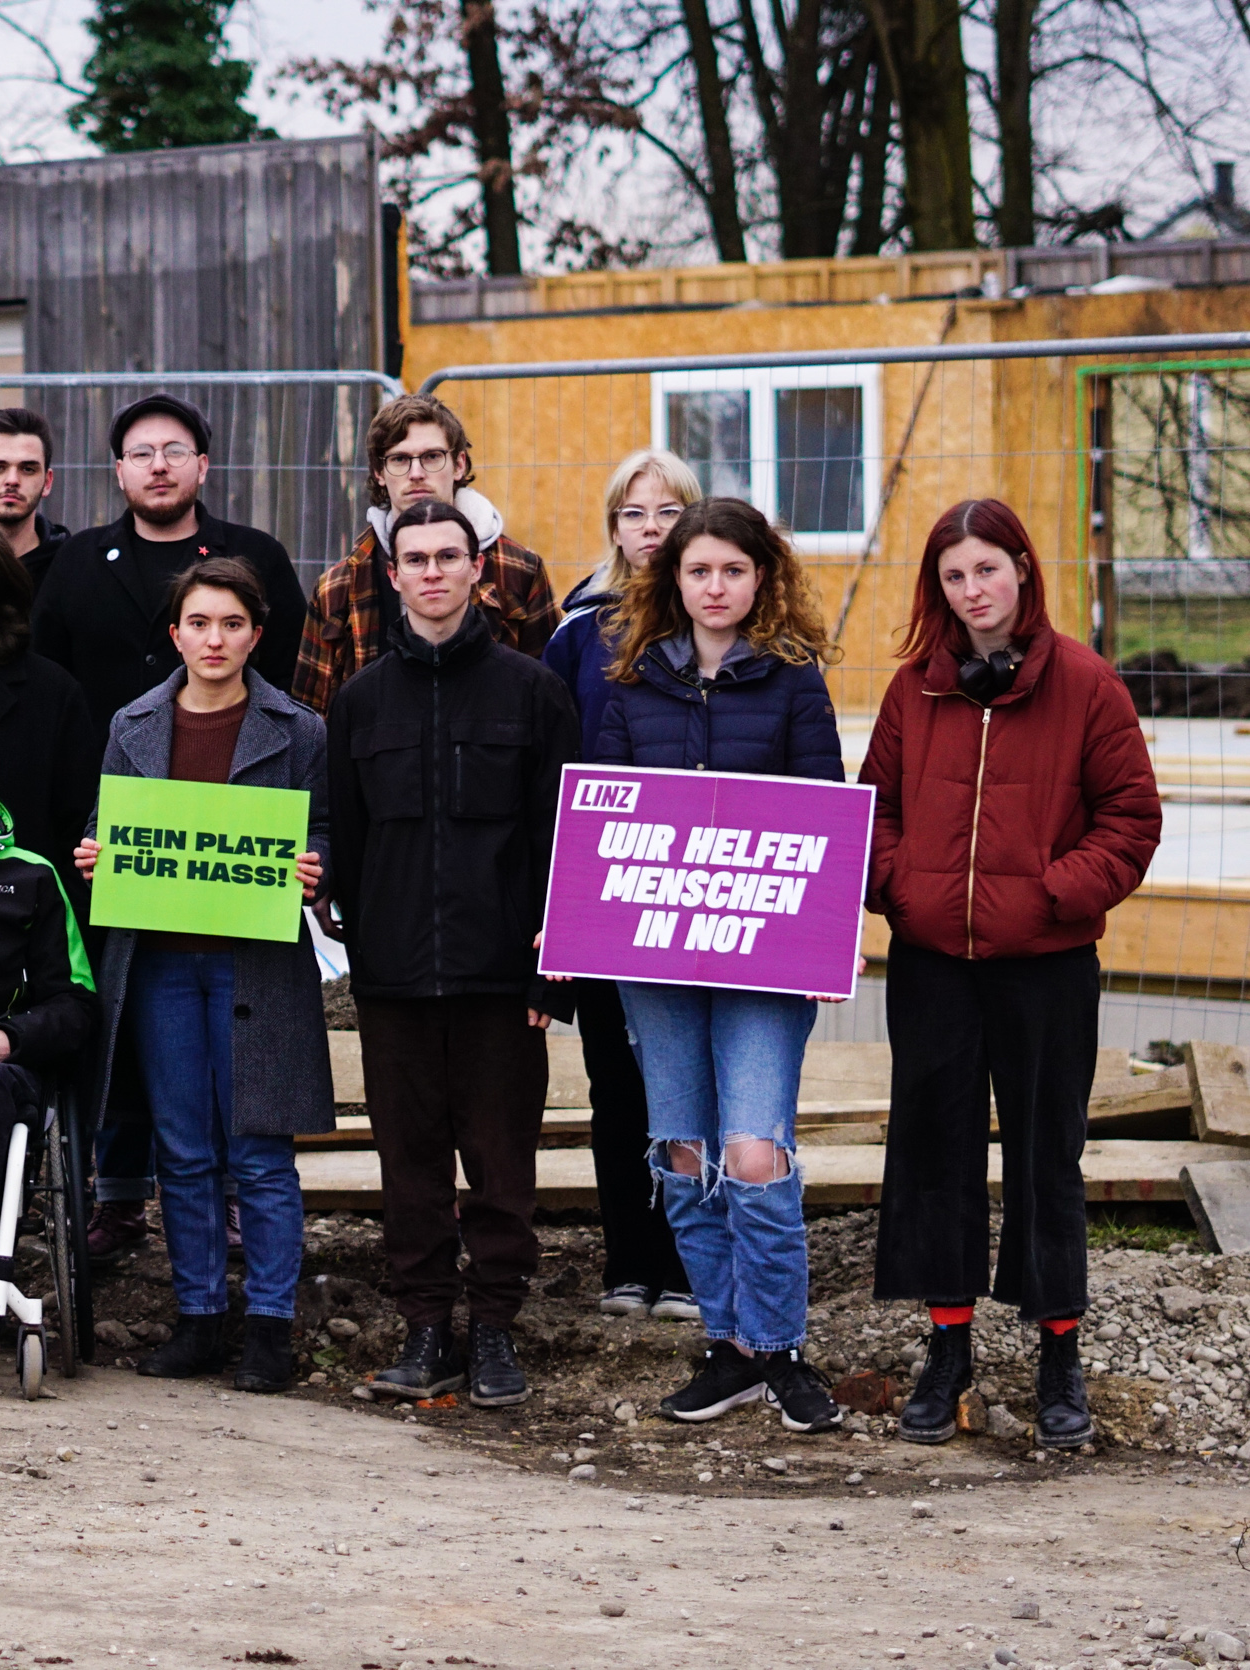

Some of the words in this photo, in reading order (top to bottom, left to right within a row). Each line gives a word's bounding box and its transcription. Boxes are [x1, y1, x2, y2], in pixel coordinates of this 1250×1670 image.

[578, 784, 634, 809] LINZ
[109, 825, 187, 851] KEIN
[195, 831, 297, 860] PLATZ
[597, 820, 676, 862] WIR
[682, 826, 829, 874] HELFEN
[113, 848, 179, 879] FÜR
[186, 859, 288, 888] HASS!
[599, 864, 808, 915] MENSCHEN
[632, 909, 680, 949] IN
[683, 913, 766, 955] NOT
